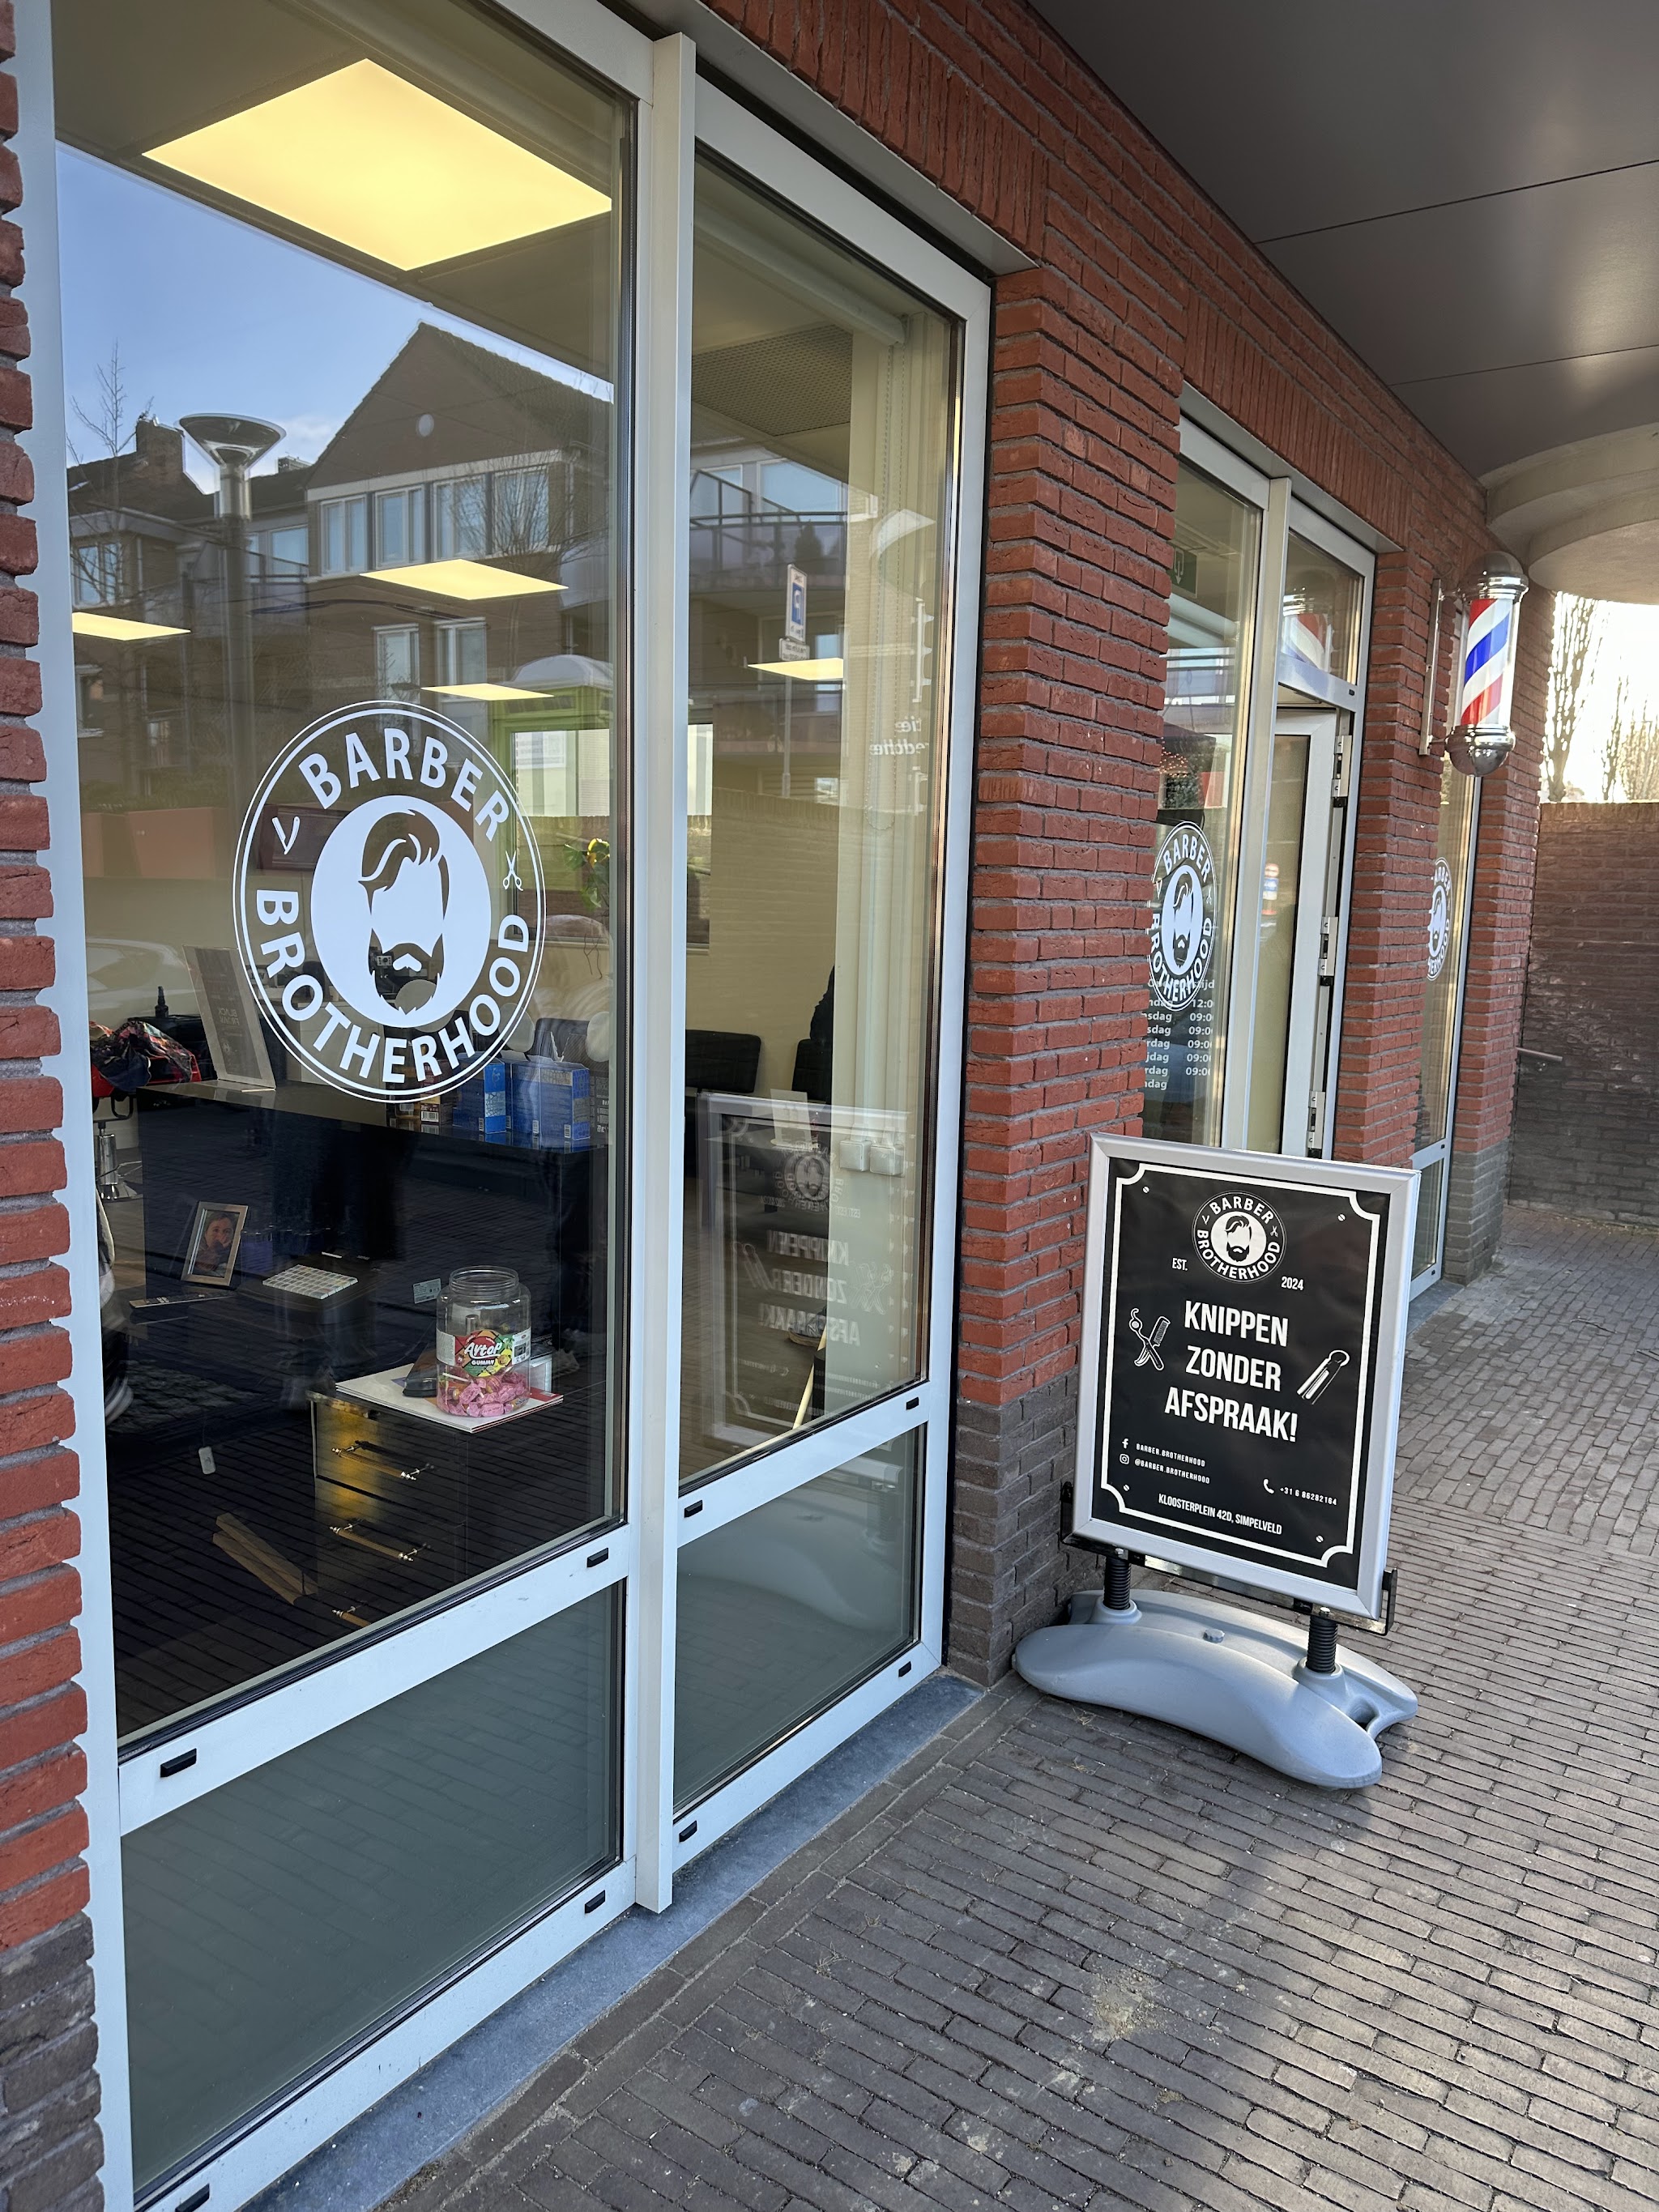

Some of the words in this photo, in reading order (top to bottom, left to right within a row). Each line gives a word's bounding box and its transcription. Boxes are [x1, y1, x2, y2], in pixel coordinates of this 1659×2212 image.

[297, 727, 510, 842] BARBER
[1162, 833, 1211, 883] BARBER
[256, 889, 530, 1084] BROTHERHOOD
[1190, 1012, 1213, 1021] 09:0
[1192, 999, 1214, 1008] 12:0
[1145, 1038, 1171, 1050] rdag
[1188, 1040, 1212, 1049] 09:0
[1146, 1025, 1171, 1036] sdag
[1188, 1026, 1213, 1035] 09:0
[1144, 1065, 1168, 1077] rdag
[1145, 1052, 1169, 1063] jdag
[1187, 1054, 1211, 1063] 09:0
[1209, 1196, 1274, 1225] BARBER
[1197, 1230, 1281, 1280] BROTHERHOOD
[1172, 1257, 1188, 1271] EST.
[1281, 1276, 1304, 1291] 2024
[1184, 1300, 1289, 1347] KNIPPEN
[1185, 1345, 1282, 1392] ZONDER
[1164, 1386, 1298, 1443] AFSPRAAK!
[1136, 1443, 1205, 1467] BARBER.BROTHERHOOD
[1134, 1459, 1210, 1484] @BARBER.BROTHERHOOD
[1280, 1486, 1293, 1495] +31
[1294, 1489, 1300, 1497] 6
[1301, 1490, 1337, 1506] 86282164
[1158, 1493, 1216, 1518] KLOOSTERPLEIN
[1216, 1509, 1235, 1524] 42D,
[1235, 1514, 1282, 1535] SIMPELVELD
